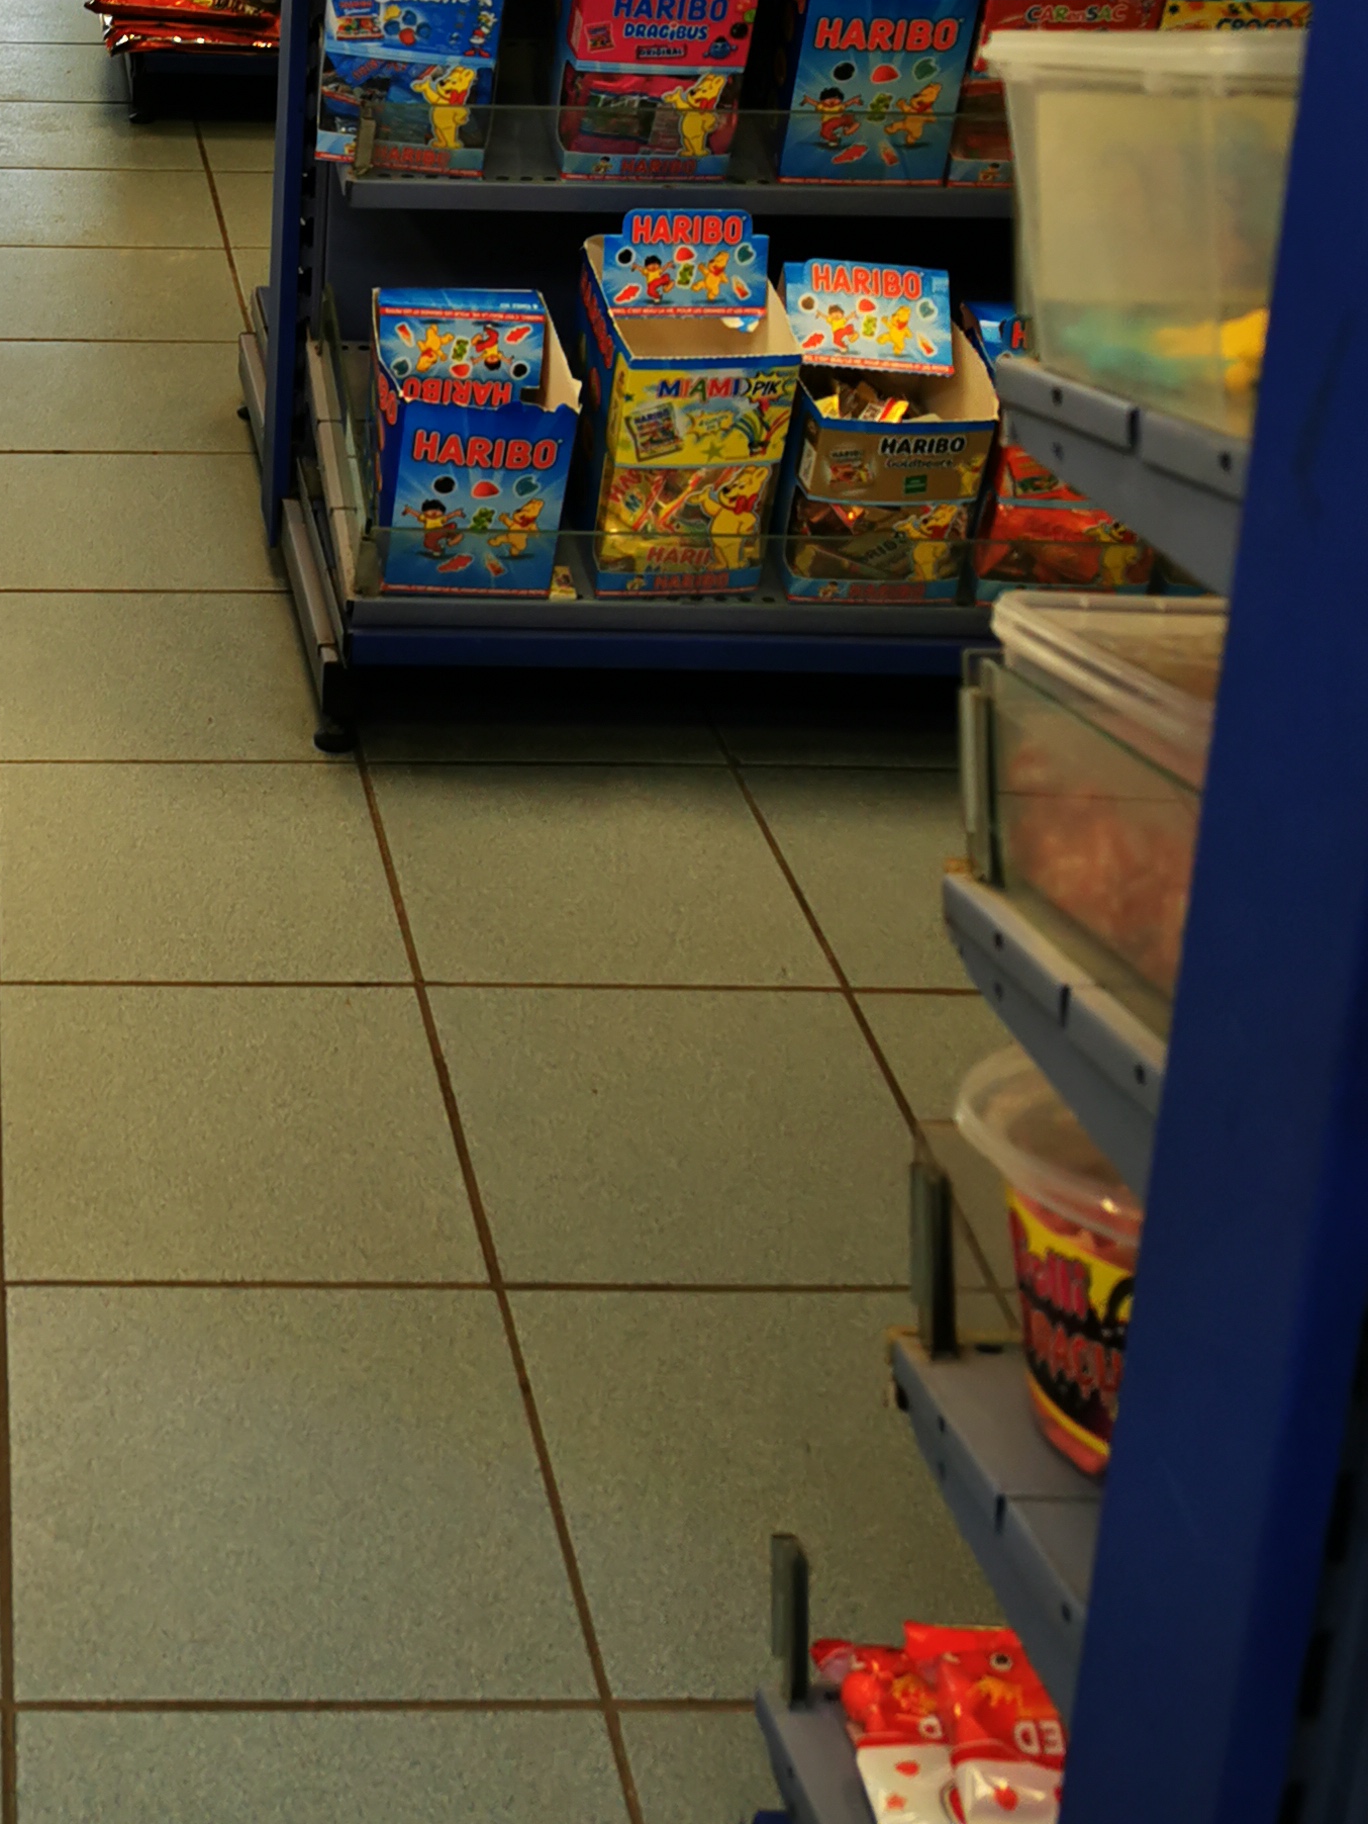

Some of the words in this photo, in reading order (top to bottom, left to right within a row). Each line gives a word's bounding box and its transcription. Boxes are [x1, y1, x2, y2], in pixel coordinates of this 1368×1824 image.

[814, 17, 960, 53] HARIBO
[620, 157, 698, 175] HARIBO
[631, 214, 744, 244] HARIBO
[810, 262, 924, 301] HARIBO
[402, 377, 512, 407] HARIBO
[656, 378, 741, 401] MIAMI
[750, 380, 779, 396] PIK
[412, 429, 559, 471] HARIBO
[879, 434, 967, 456] HARIBO
[646, 546, 711, 566] HARI
